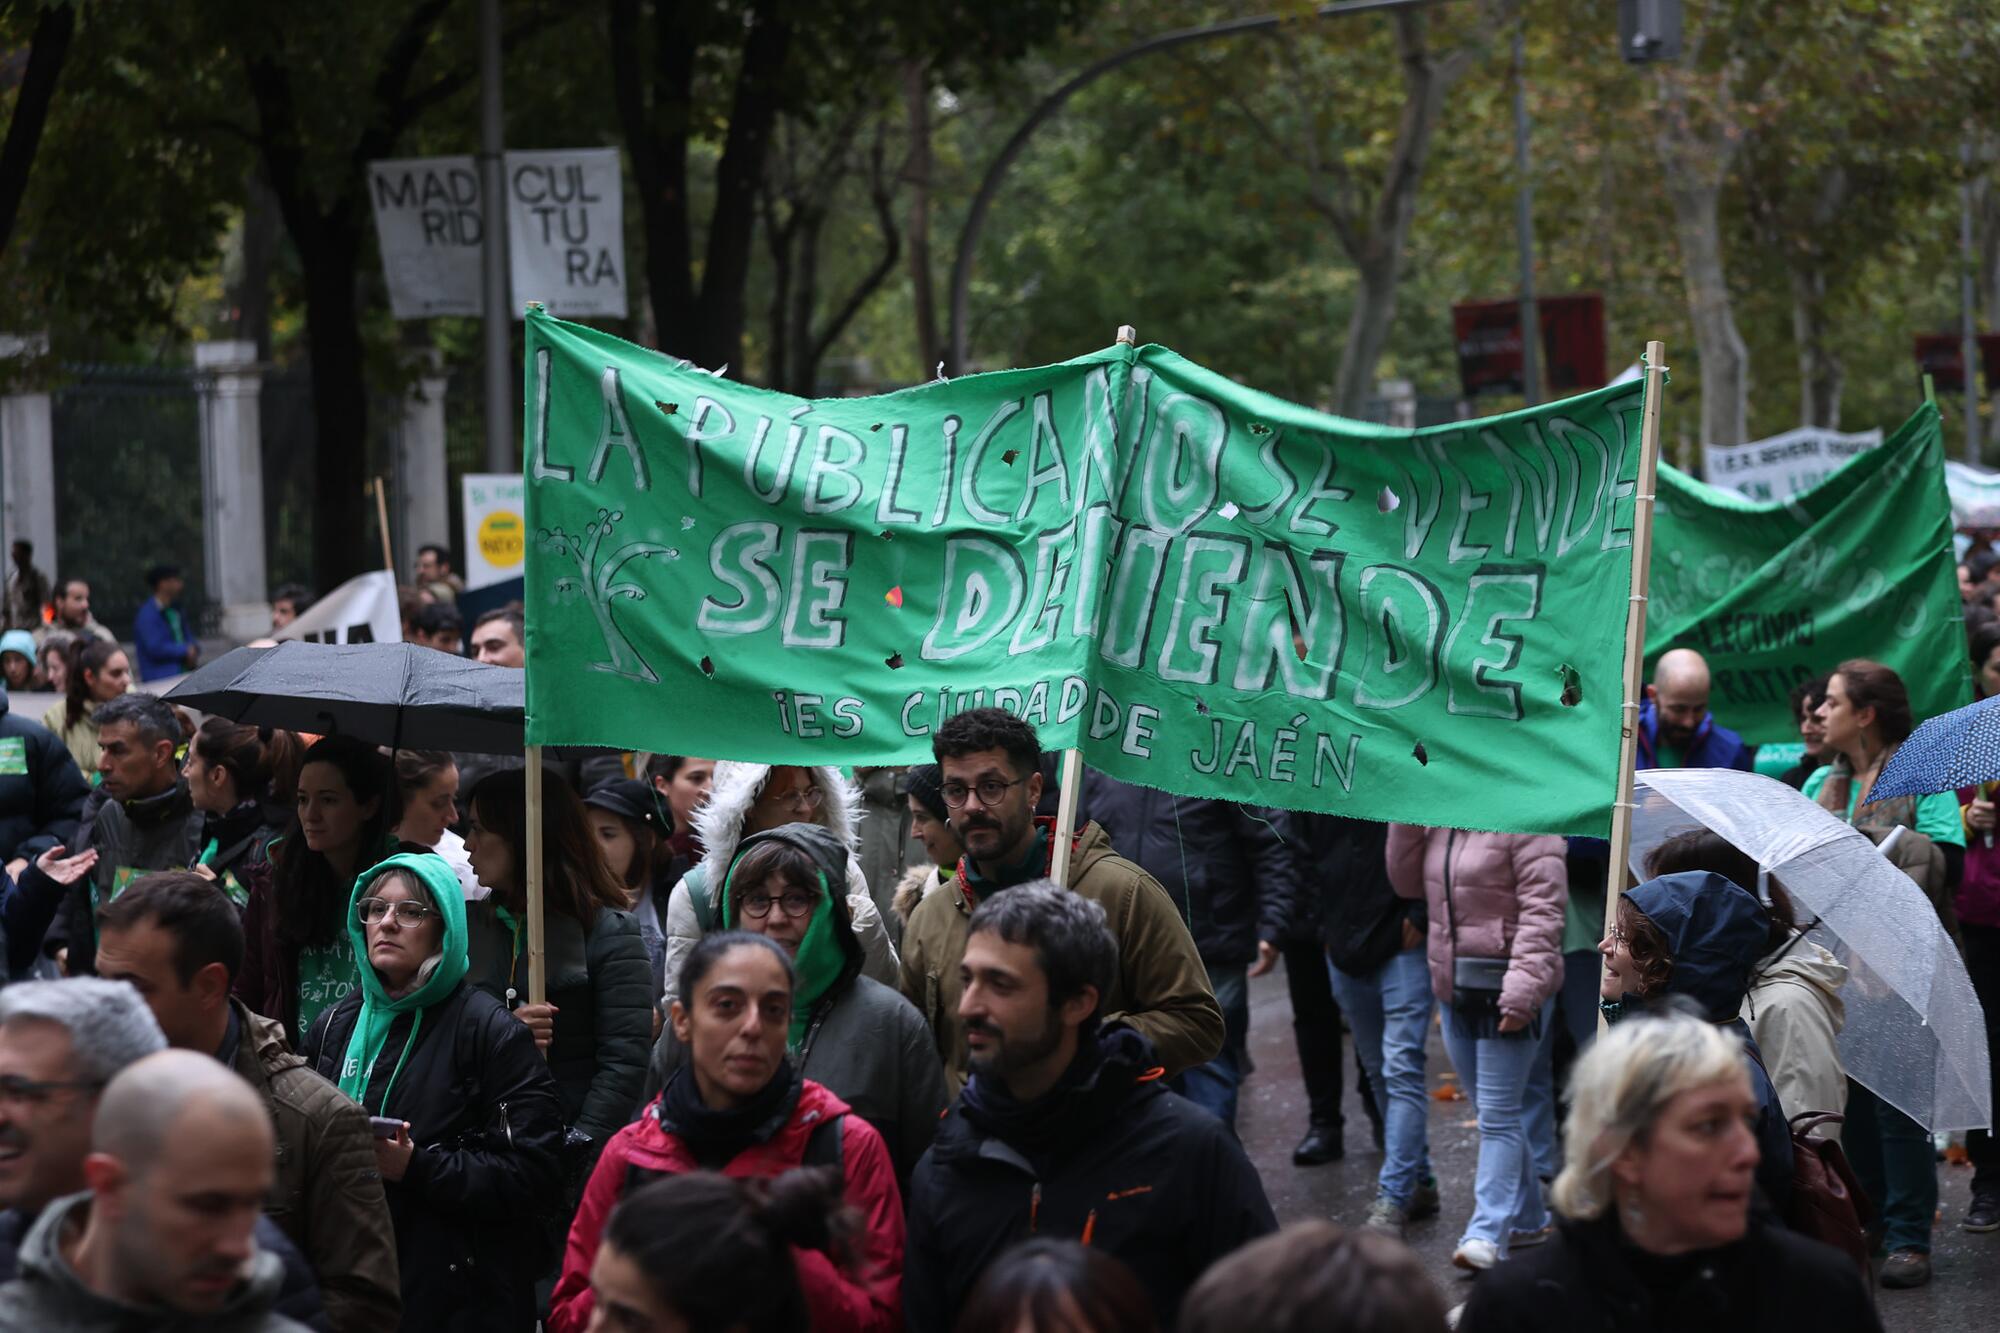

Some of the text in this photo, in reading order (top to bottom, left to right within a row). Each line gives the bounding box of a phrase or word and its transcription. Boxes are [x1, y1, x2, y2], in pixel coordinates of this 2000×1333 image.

[378, 168, 479, 212] MAD
[513, 164, 600, 205] CUL
[421, 208, 485, 247] RID
[531, 207, 589, 246] TU
[567, 249, 620, 287] RA
[533, 347, 651, 491] LA
[1074, 365, 1230, 536] NO
[1240, 425, 1354, 538] SE
[1376, 392, 1643, 564] VENDE
[697, 520, 855, 649] SE
[1088, 688, 1160, 759] DE
[1191, 713, 1362, 793] JAÉN
